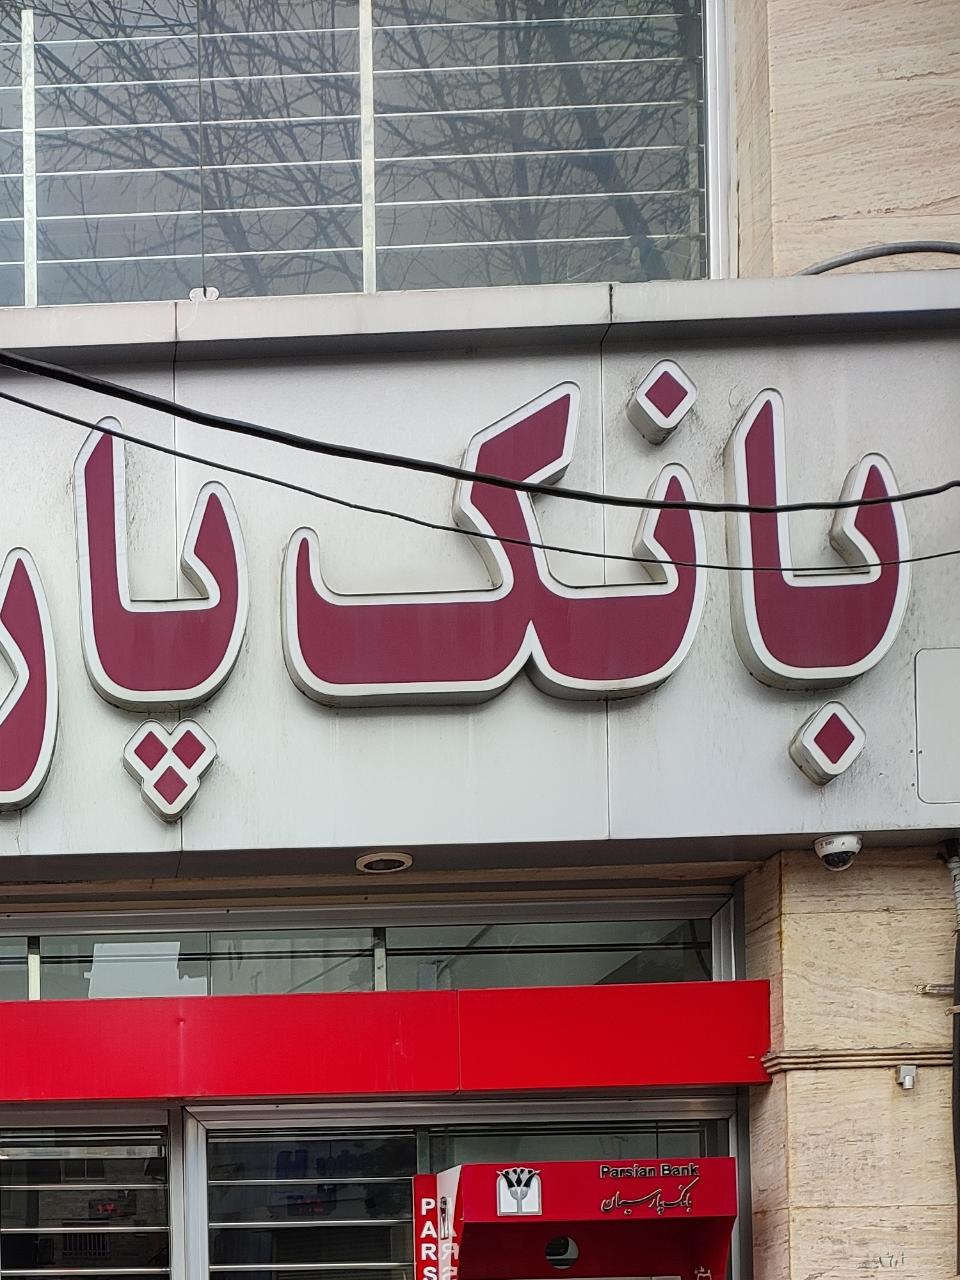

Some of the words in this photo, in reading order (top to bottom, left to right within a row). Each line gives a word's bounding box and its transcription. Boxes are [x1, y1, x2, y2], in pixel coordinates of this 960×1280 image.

[285, 362, 910, 780] بانک
[600, 1163, 657, 1178] Parsian
[660, 1162, 700, 1177] Bank
[600, 1188, 665, 1216] پارسیان
